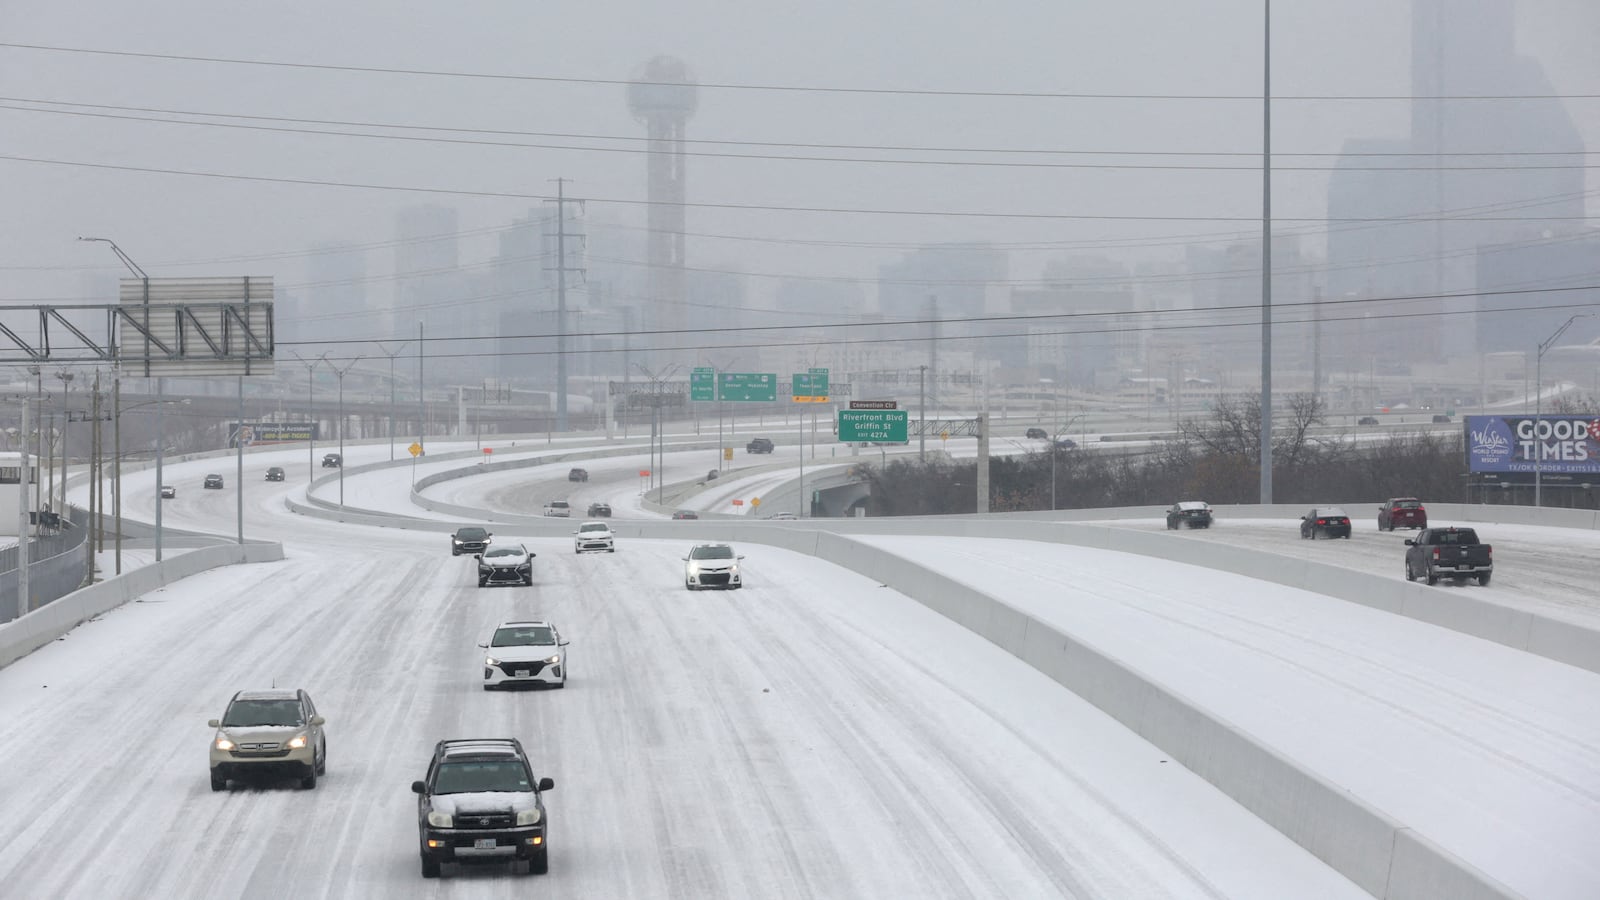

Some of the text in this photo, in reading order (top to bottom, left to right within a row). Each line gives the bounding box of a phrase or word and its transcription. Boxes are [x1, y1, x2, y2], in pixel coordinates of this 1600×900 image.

[843, 413, 904, 421] Riverfront Blvd
[854, 422, 892, 430] Griffin St
[1517, 420, 1589, 440] GOOD
